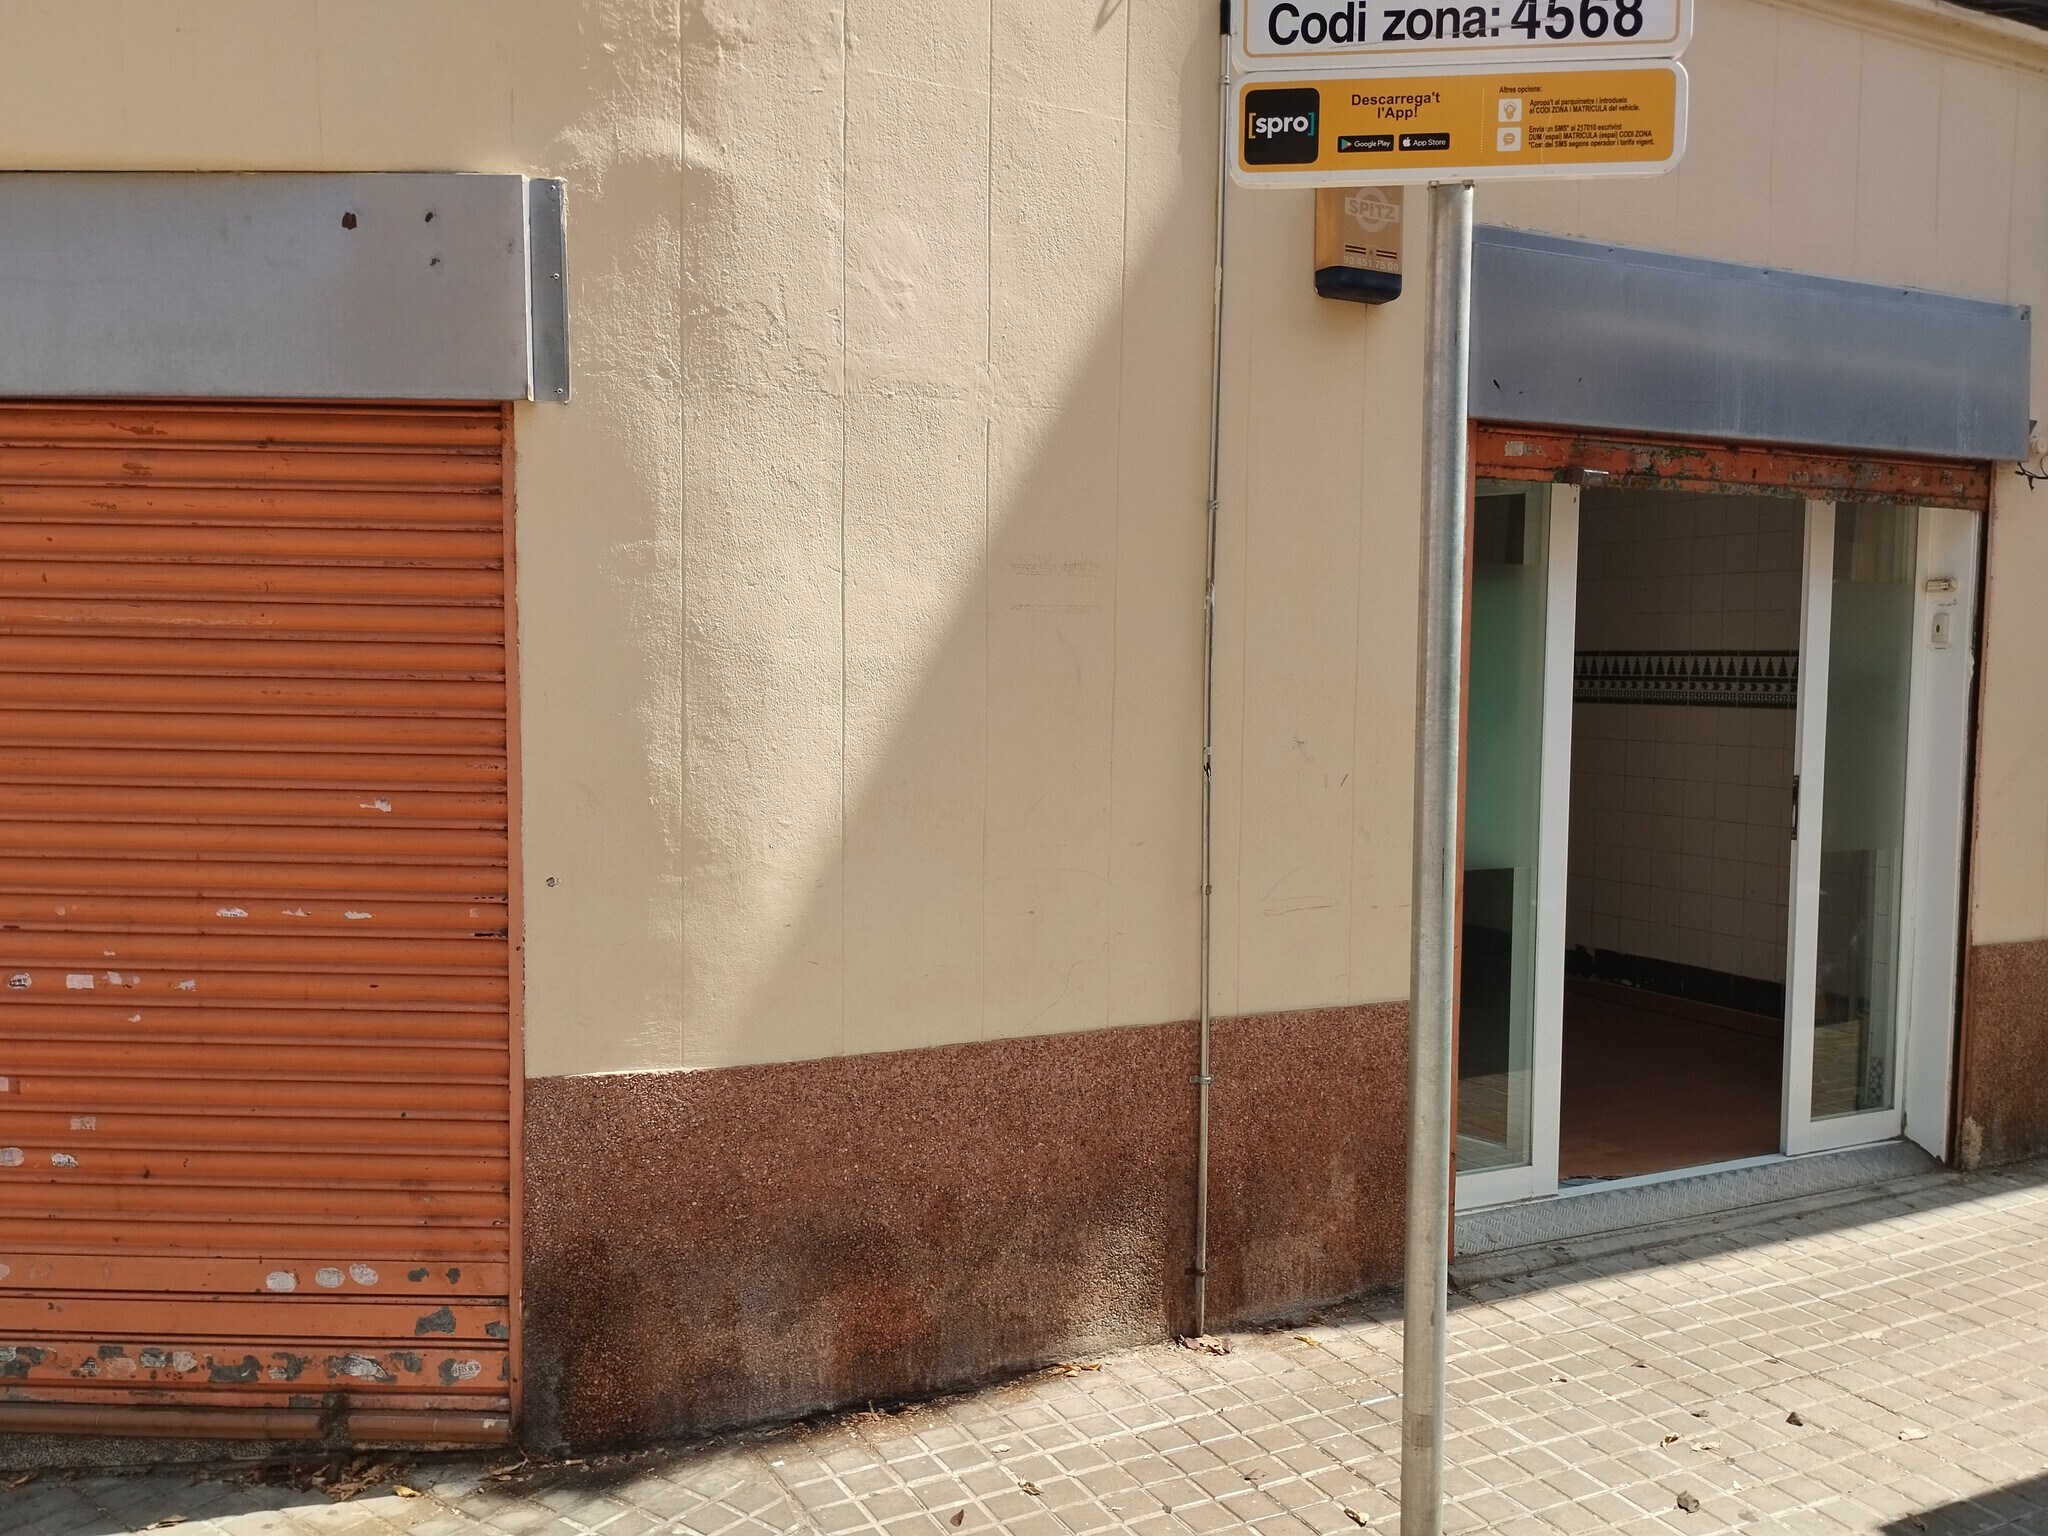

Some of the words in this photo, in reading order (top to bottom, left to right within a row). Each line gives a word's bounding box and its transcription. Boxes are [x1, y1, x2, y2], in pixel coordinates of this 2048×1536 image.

[1268, 1, 1366, 46] Codi
[1382, 6, 1500, 41] zona:
[1511, 0, 1643, 40] 4568
[1517, 86, 1542, 94] opcions:
[1351, 91, 1440, 107] Descarrega't
[1599, 96, 1627, 104] introdueix
[1377, 106, 1418, 121] l'App!
[1551, 105, 1568, 113] ZONA
[1608, 104, 1618, 112] del
[1618, 104, 1640, 112] vehicle.
[1597, 123, 1622, 131] escrivint
[1528, 133, 1542, 141] DUM
[1618, 130, 1634, 138] CODI
[1635, 130, 1652, 138] ZONA
[1354, 140, 1377, 148] Google
[1377, 139, 1390, 147] Play
[1413, 139, 1427, 147] App
[1428, 138, 1446, 146] Store
[1554, 140, 1568, 148] SMS
[1568, 140, 1589, 149] segons
[1590, 138, 1616, 148] operador
[1348, 199, 1396, 220] SPITZ
